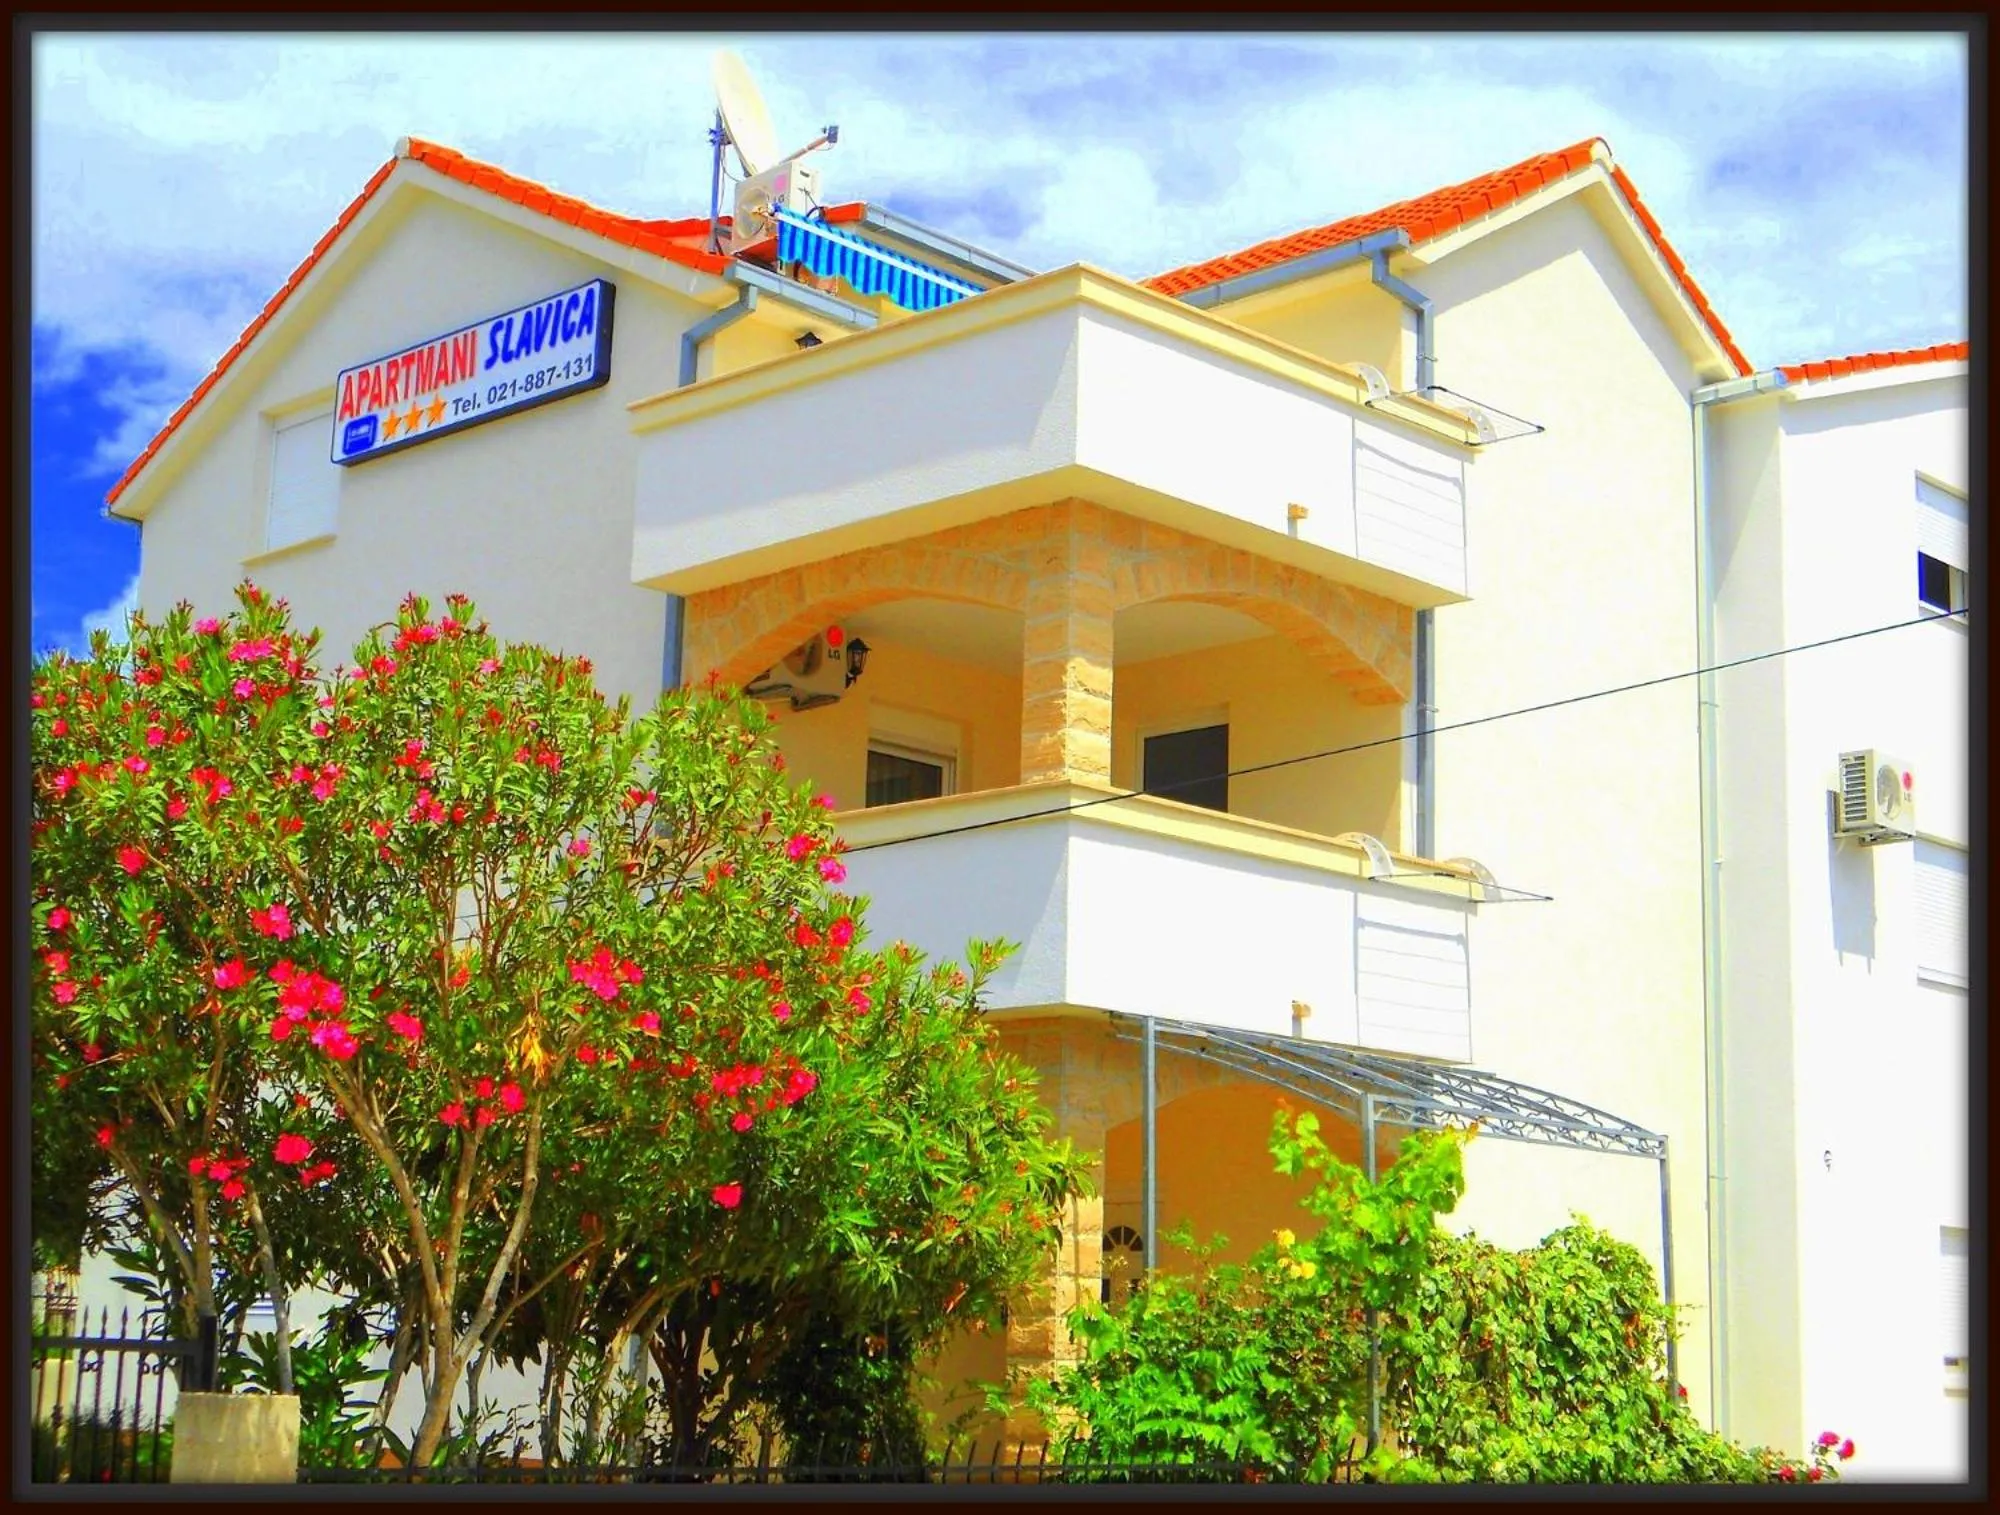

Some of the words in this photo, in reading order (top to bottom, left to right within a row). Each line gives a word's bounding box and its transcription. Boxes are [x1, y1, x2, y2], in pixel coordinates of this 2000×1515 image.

[339, 330, 477, 421] APARTMANI
[484, 287, 595, 370] SLAVICA
[452, 393, 481, 415] Tel.
[488, 353, 593, 404] 021-887-131
[828, 649, 840, 660] LG
